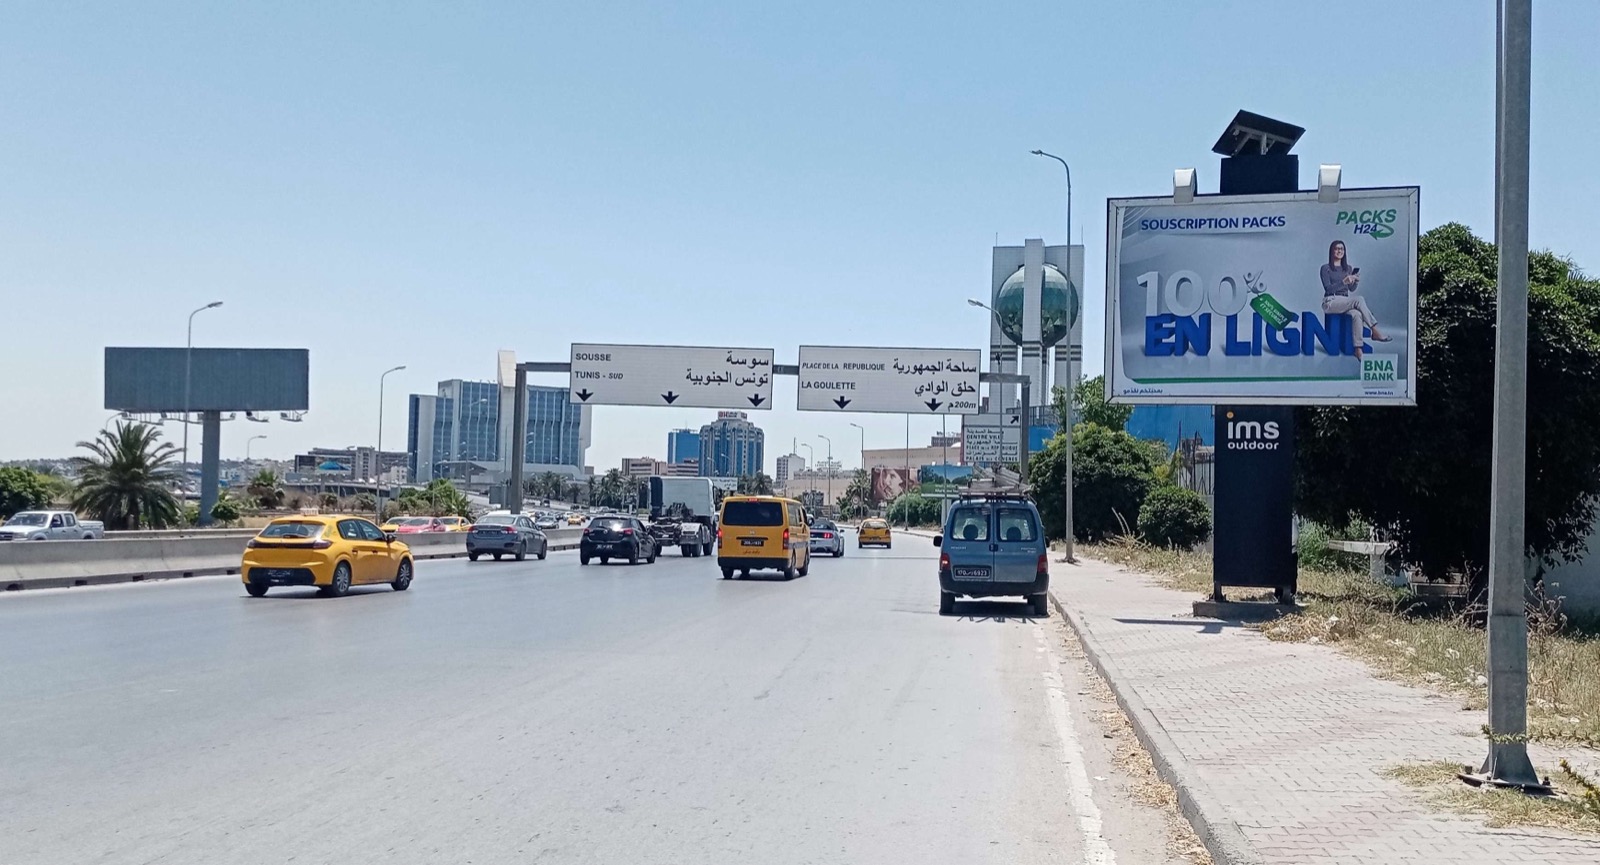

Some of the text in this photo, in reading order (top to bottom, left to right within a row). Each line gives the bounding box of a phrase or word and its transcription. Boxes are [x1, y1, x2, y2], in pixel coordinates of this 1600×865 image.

[1141, 215, 1286, 231] SOUSCRIPTION PACKS
[1336, 209, 1397, 225] PACKS
[1354, 224, 1377, 234] H24
[1136, 270, 1267, 316] 100%
[1145, 313, 1211, 357] EN
[575, 353, 612, 362] SOUSSE
[726, 351, 769, 369] سوسة
[892, 357, 977, 374] ساحة الجمهورية
[1363, 360, 1394, 371] BNA
[802, 362, 822, 370] PLACE
[843, 363, 885, 371] REPUBLIQUE
[575, 370, 601, 380] TUNIS
[608, 372, 624, 380] SUD
[685, 368, 769, 387] تونس الجنوبية
[1363, 372, 1394, 381] BANK
[801, 381, 856, 390] LA GOULETTE
[914, 380, 976, 397] حلق الوادي
[1226, 411, 1280, 439] ims
[1227, 440, 1279, 450] outdoor
